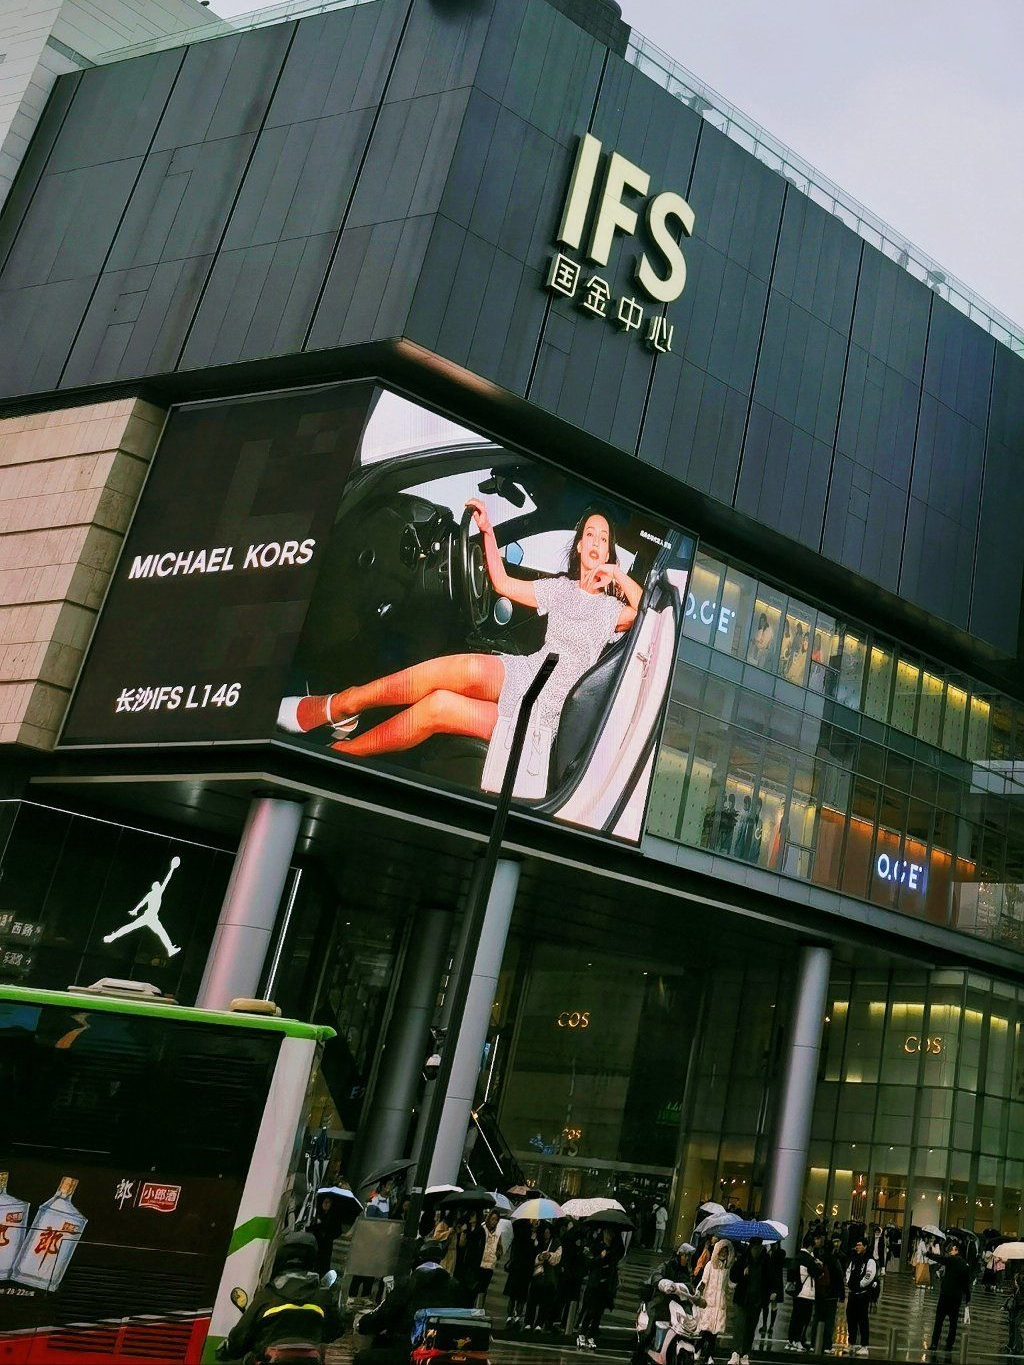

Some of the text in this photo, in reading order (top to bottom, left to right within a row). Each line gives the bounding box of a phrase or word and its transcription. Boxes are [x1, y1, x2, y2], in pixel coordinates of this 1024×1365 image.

[557, 132, 695, 302] IFS
[548, 253, 673, 352] 国金中心
[128, 539, 316, 579] MICHAEL KORS
[115, 683, 241, 713] 长沙IFS L146
[558, 1012, 590, 1028] COS
[815, 1203, 838, 1216] CS
